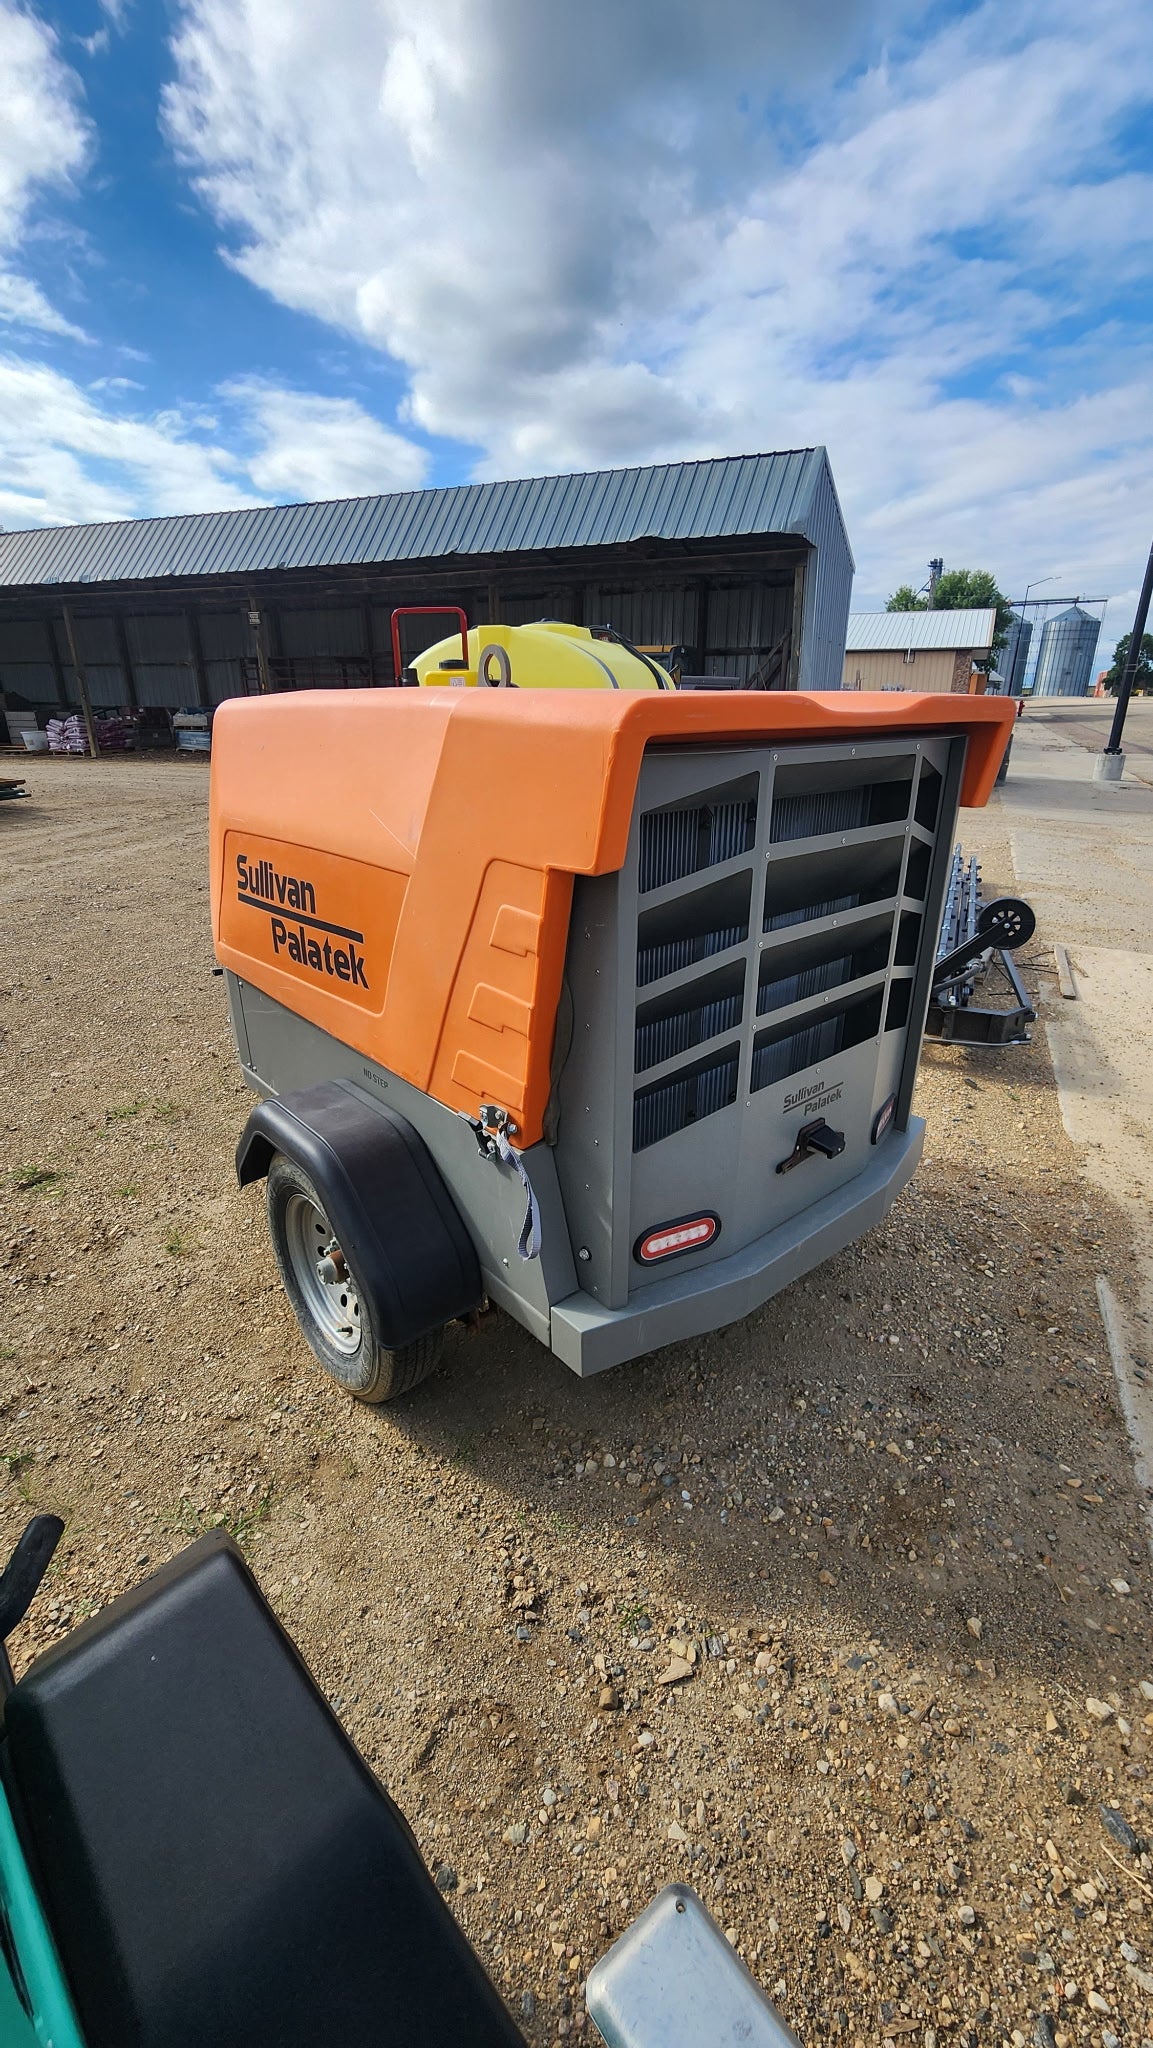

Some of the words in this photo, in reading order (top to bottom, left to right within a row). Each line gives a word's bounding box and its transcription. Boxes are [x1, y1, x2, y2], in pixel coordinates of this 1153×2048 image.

[236, 854, 316, 914] Sullivan
[271, 917, 369, 990] Palatek
[363, 1067, 372, 1080] NO
[372, 1073, 388, 1088] STEP
[784, 1081, 824, 1108] Sullivan
[804, 1088, 842, 1116] Palatek
